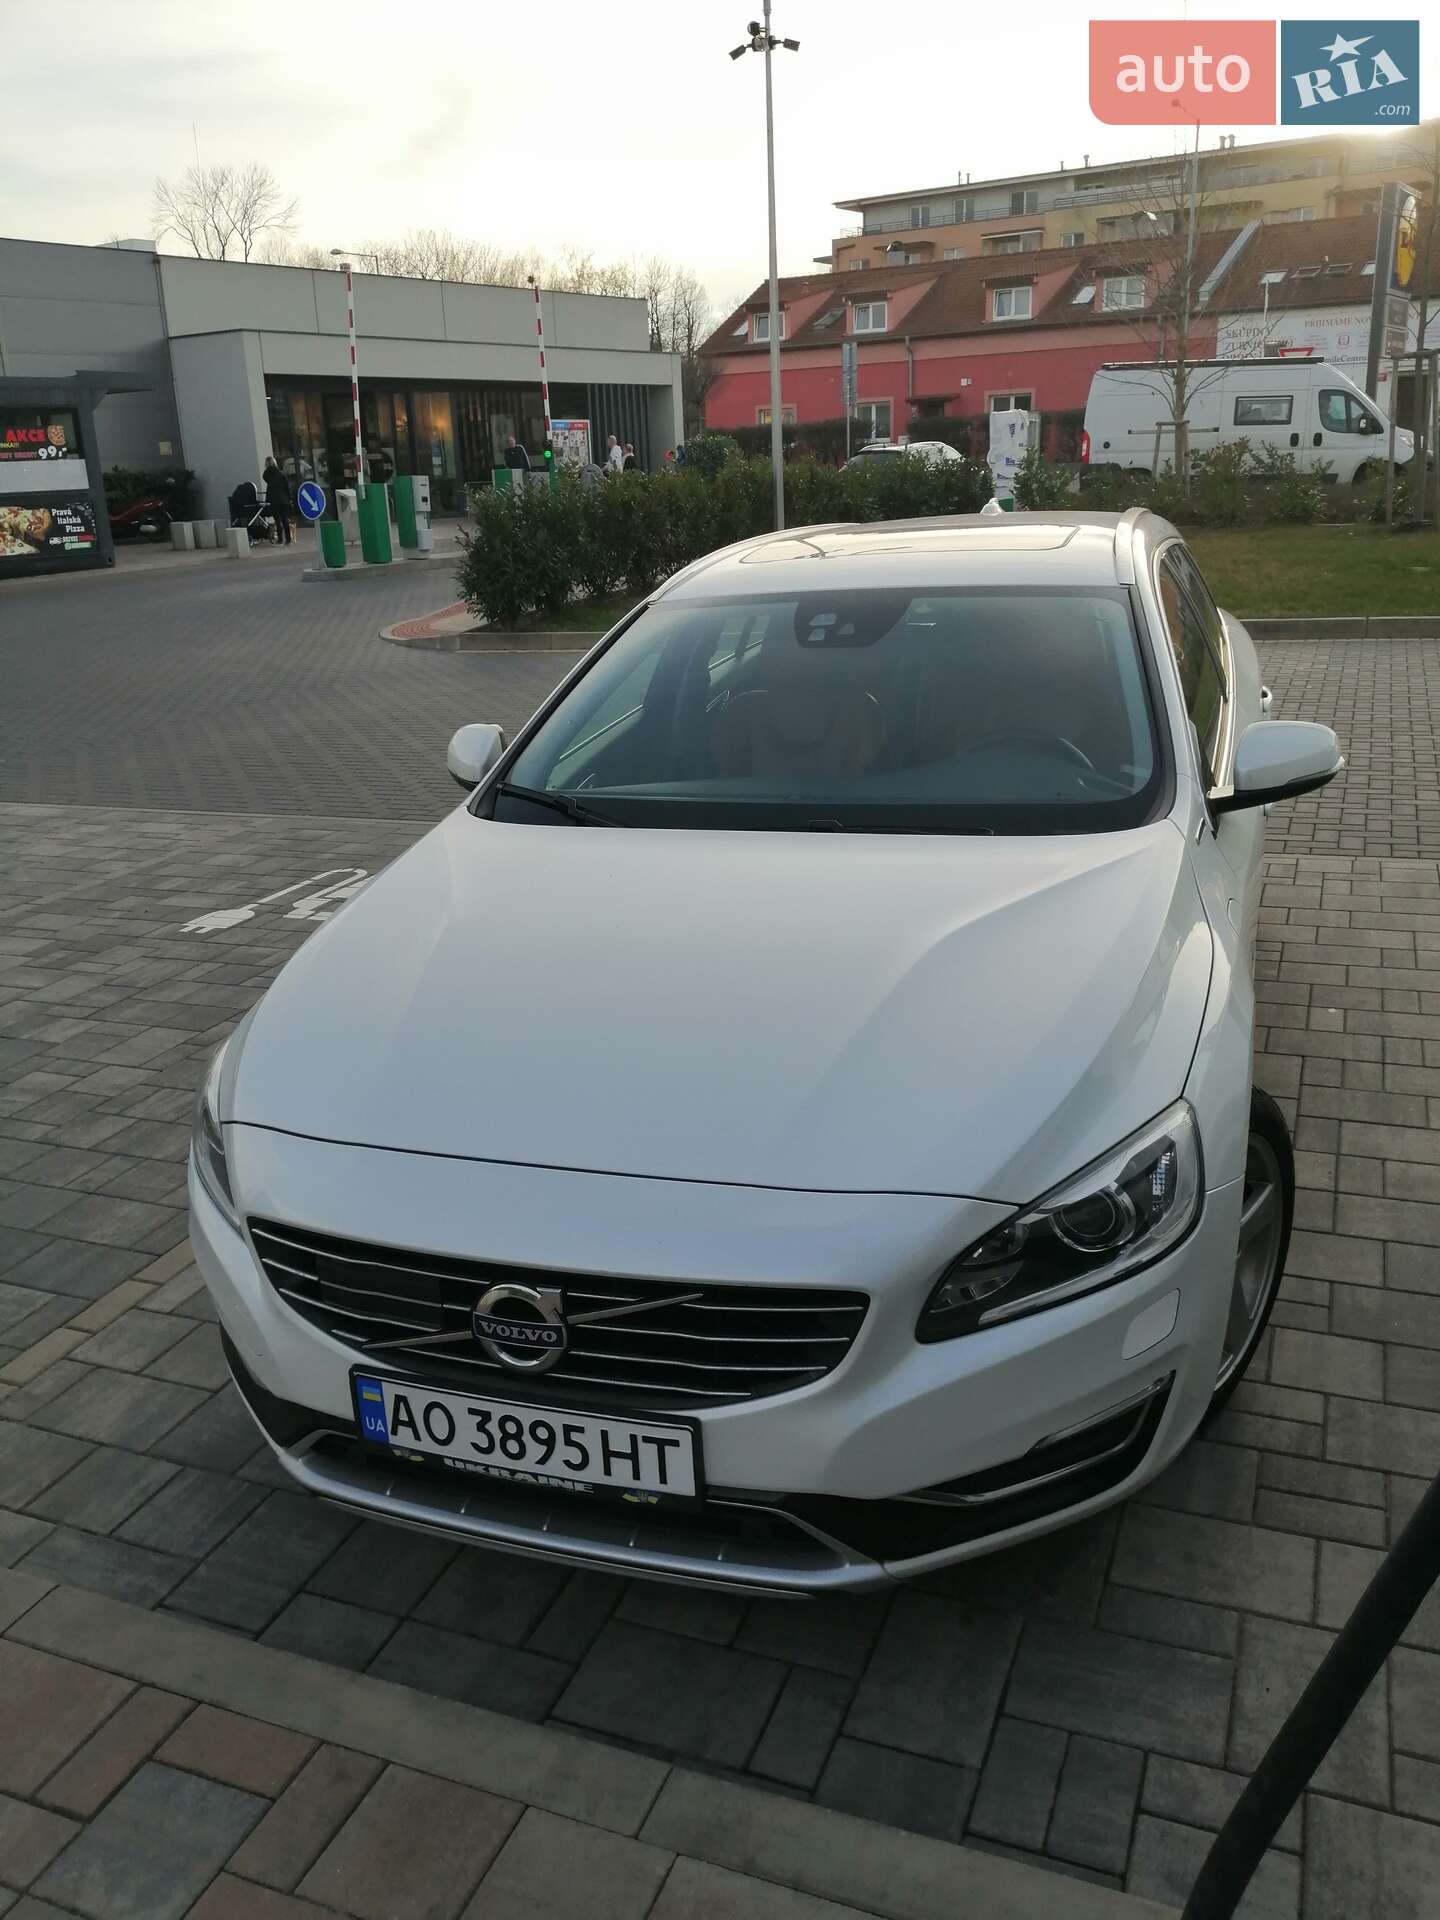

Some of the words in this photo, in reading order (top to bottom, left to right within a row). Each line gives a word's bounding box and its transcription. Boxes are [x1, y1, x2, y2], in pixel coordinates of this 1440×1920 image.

[6, 429, 46, 442] AKCE
[51, 507, 72, 516] Pravá
[65, 525, 85, 533] Pizza
[478, 1320, 558, 1343] VOLVO
[366, 1416, 386, 1434] UA
[390, 1393, 456, 1447] AO
[467, 1407, 590, 1472] 3895
[600, 1429, 680, 1486] HT
[443, 1457, 595, 1494] UKRAINE
